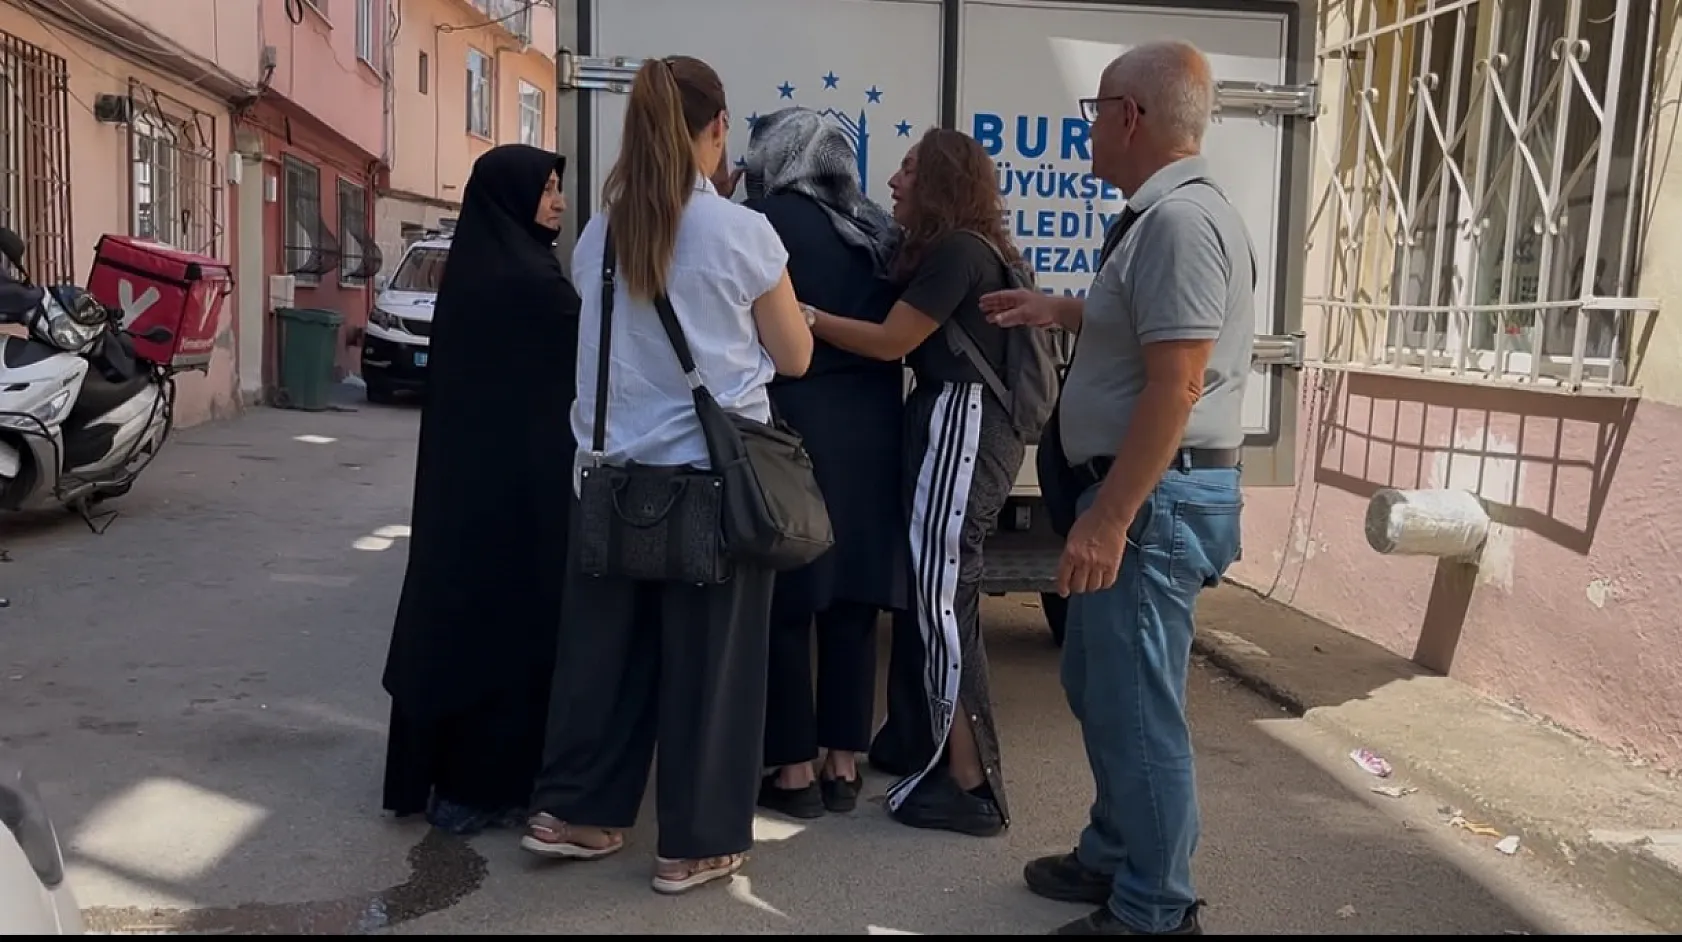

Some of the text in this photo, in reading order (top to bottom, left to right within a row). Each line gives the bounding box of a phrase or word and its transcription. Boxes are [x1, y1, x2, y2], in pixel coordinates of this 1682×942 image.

[974, 114, 1091, 160] BUR
[996, 162, 1118, 204] ÜYÜKŞE
[1001, 204, 1119, 240] LEDİY
